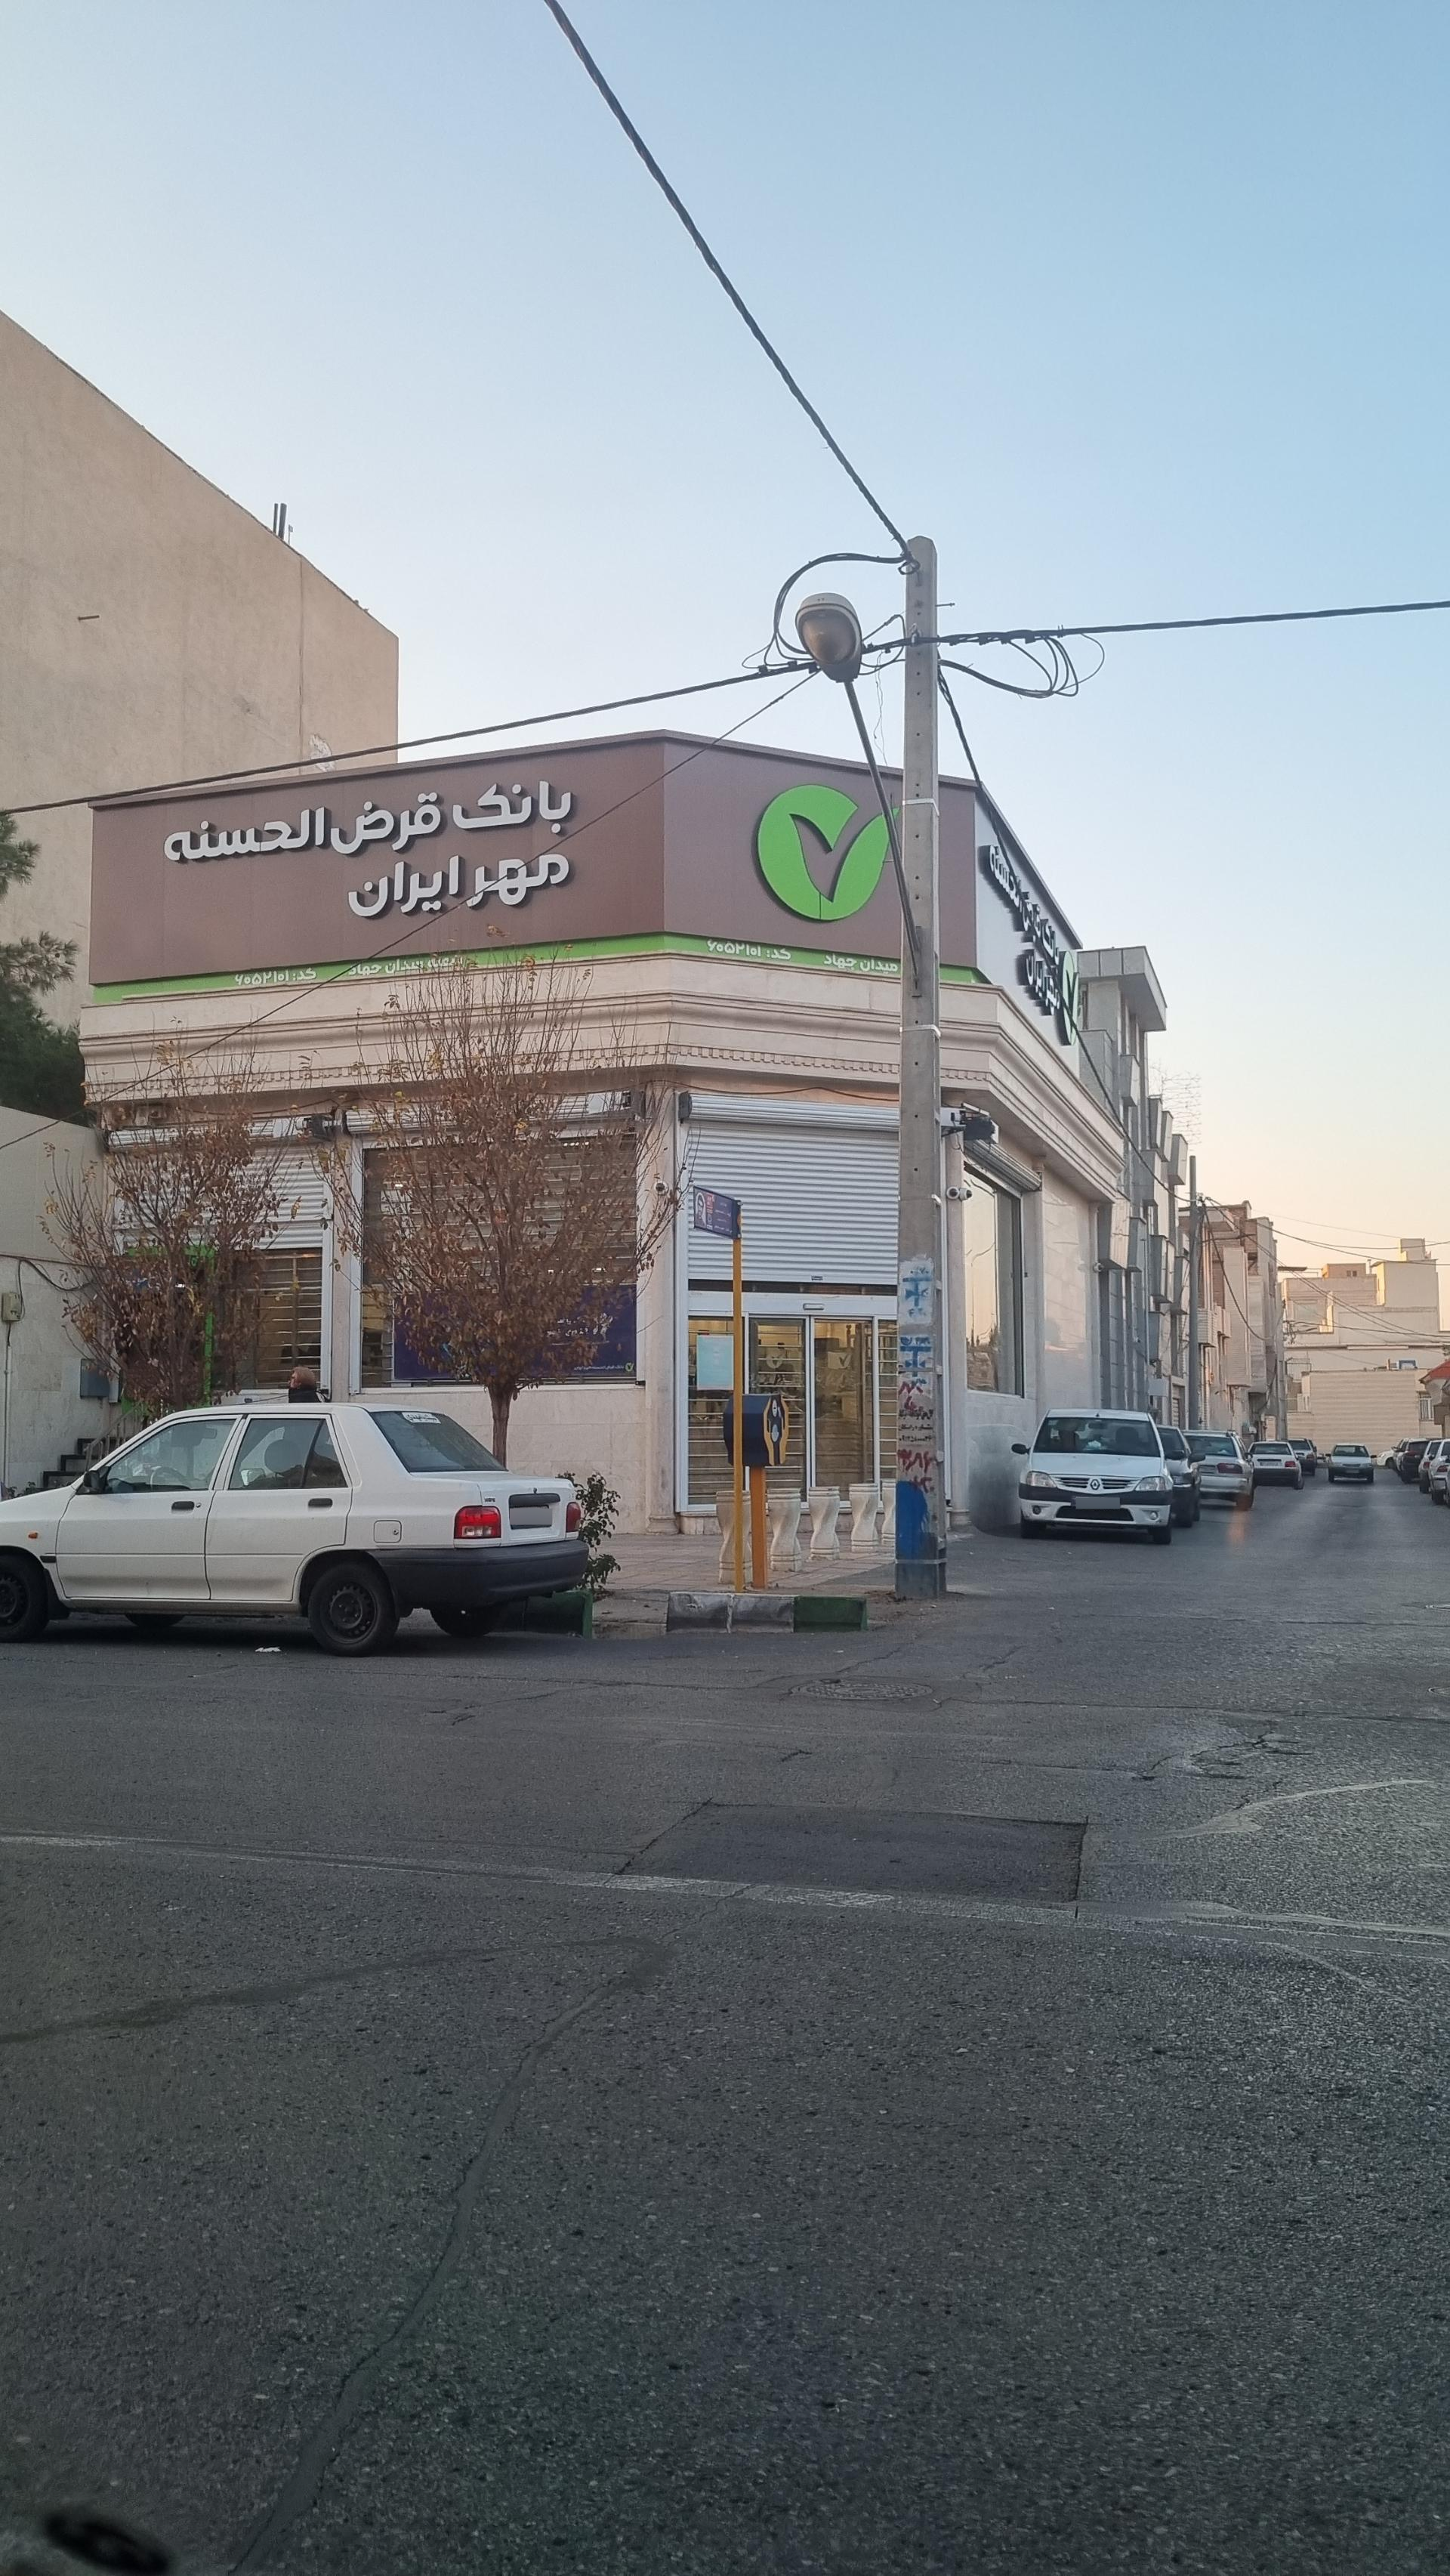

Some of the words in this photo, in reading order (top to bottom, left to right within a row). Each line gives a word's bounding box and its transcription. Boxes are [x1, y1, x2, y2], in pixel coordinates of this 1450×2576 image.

[164, 806, 326, 861] الحسنه
[330, 792, 441, 854] قرض
[452, 780, 571, 834] بانک
[348, 854, 459, 917] ایران
[466, 854, 569, 907] مهر
[766, 947, 792, 961] کد:
[823, 954, 858, 971] جهاد
[859, 959, 899, 974] میدان
